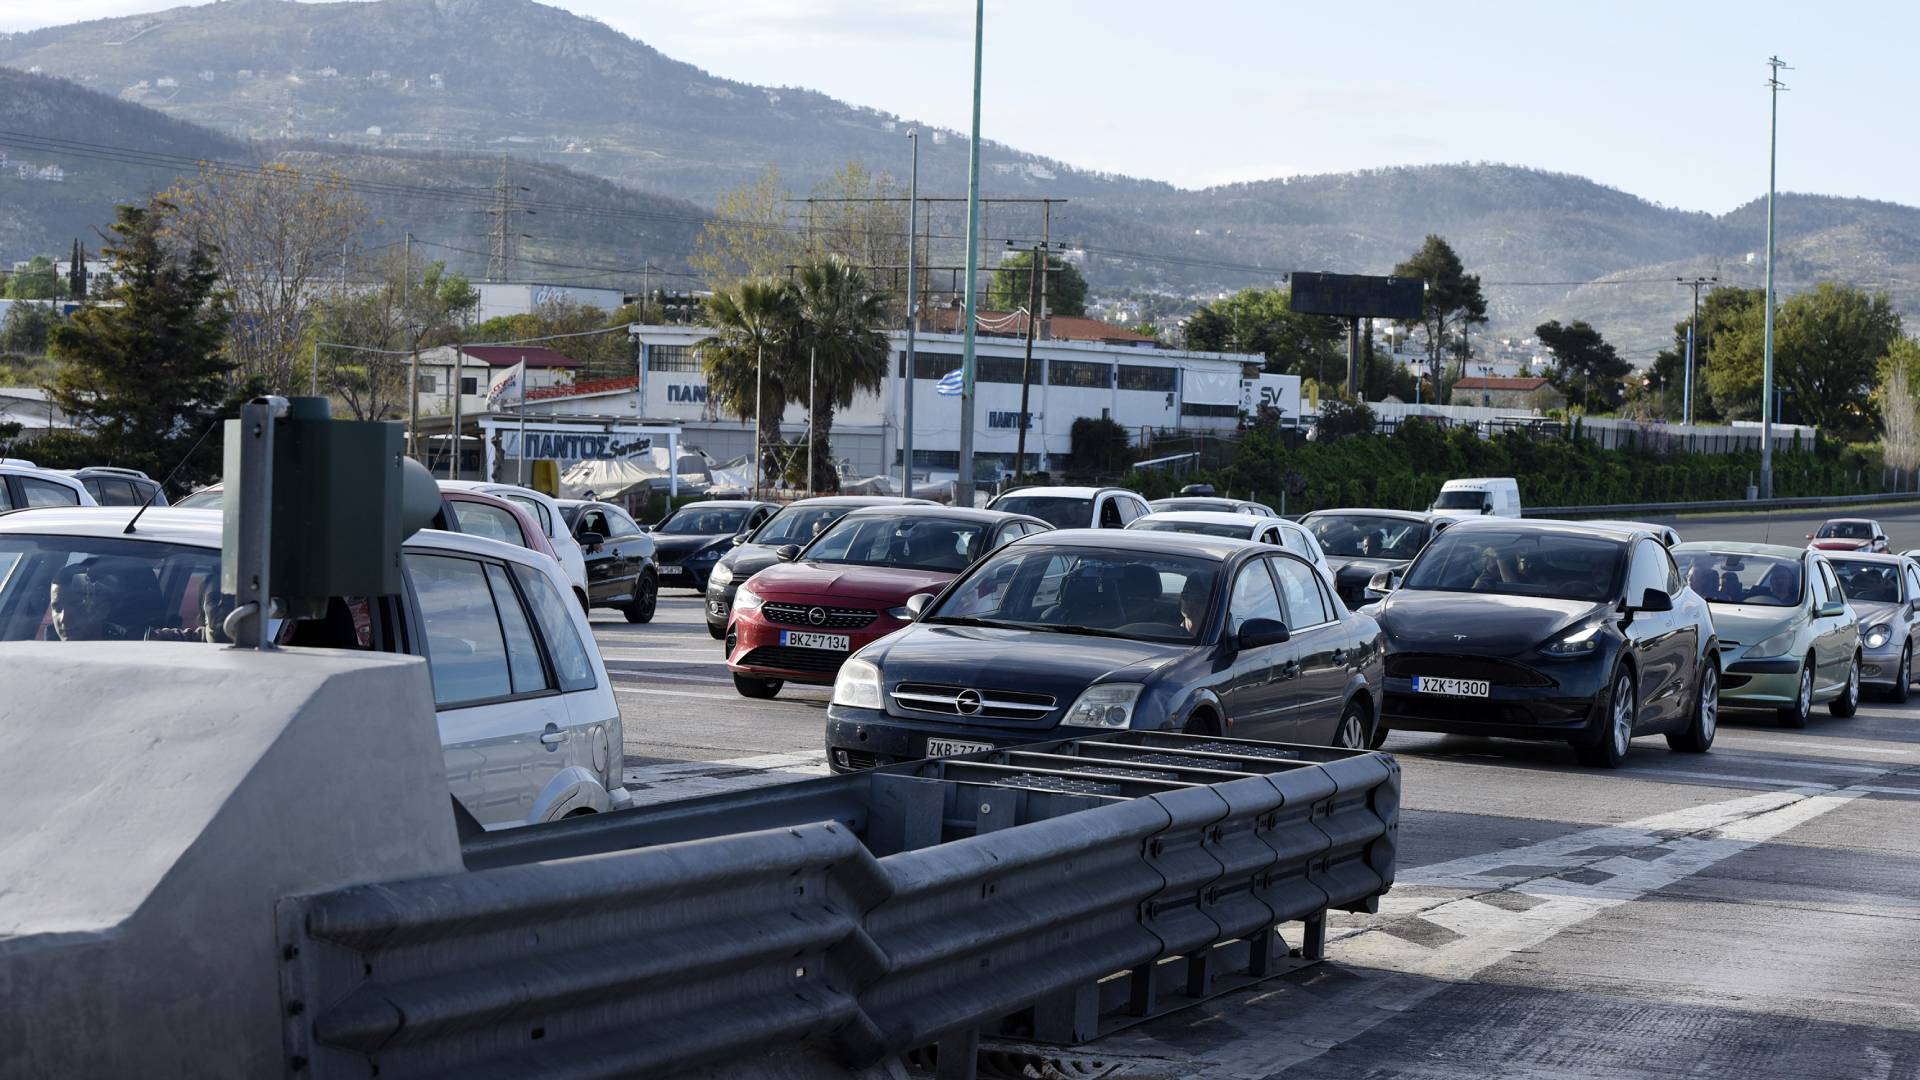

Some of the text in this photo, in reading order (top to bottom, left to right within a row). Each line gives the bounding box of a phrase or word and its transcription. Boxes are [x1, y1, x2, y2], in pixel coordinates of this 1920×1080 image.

[1260, 386, 1283, 405] SV
[525, 433, 651, 460] ΠΑΝΤΟΣ Service
